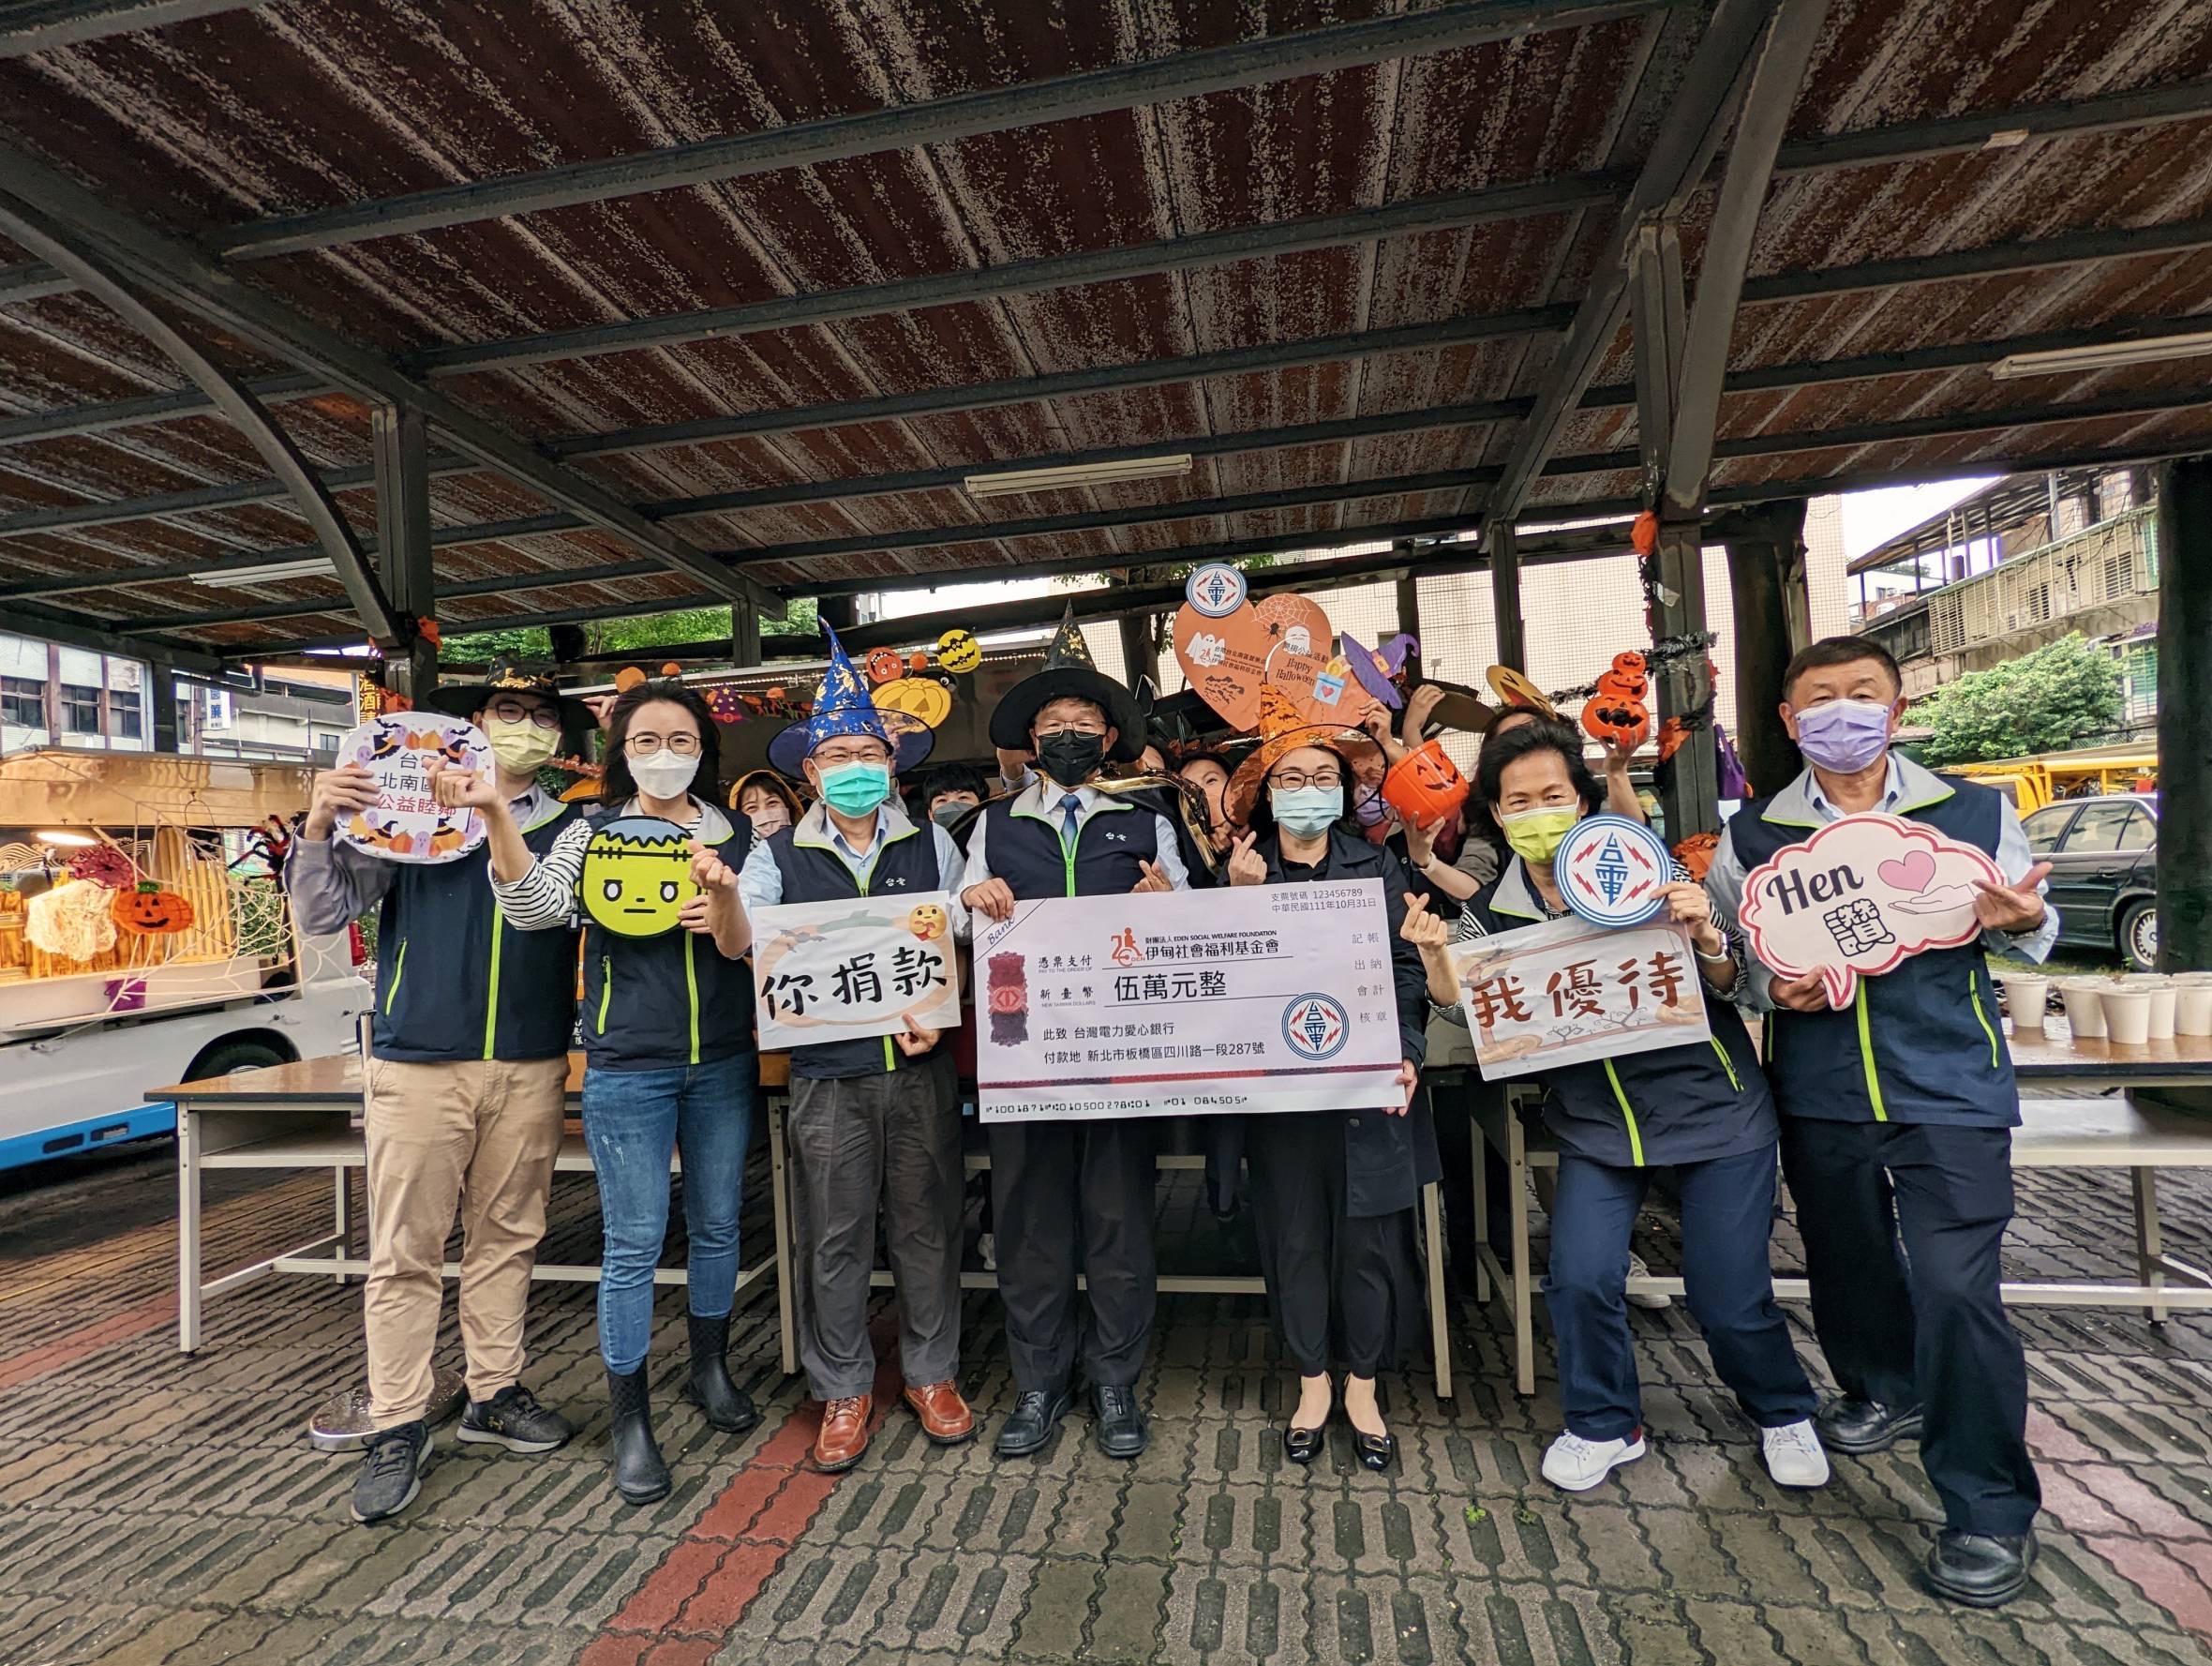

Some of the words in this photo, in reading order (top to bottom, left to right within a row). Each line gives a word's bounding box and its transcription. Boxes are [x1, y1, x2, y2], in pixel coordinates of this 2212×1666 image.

[1286, 657, 1313, 674] Happy
[1276, 668, 1315, 686] Halloween
[1271, 891, 1308, 903] 支票號碼
[1313, 888, 1363, 899] 123456789
[1766, 864, 1864, 915] Hen
[1272, 897, 1377, 913] 中華民國111年10月31日
[1239, 930, 1277, 938] FOUNDATION
[1145, 938, 1279, 961] 伊甸社會福利基金會
[761, 946, 948, 1020] 你捐款
[1114, 970, 1227, 1001] 伍萬元整
[1472, 952, 1684, 1028] 我優待
[1043, 1028, 1068, 1041] 此致
[1074, 1022, 1174, 1040] 台灣電力愛心銀行
[1044, 1051, 1082, 1064] 付款地
[1087, 1042, 1265, 1062] 新北市板橋區四川路一段287號
